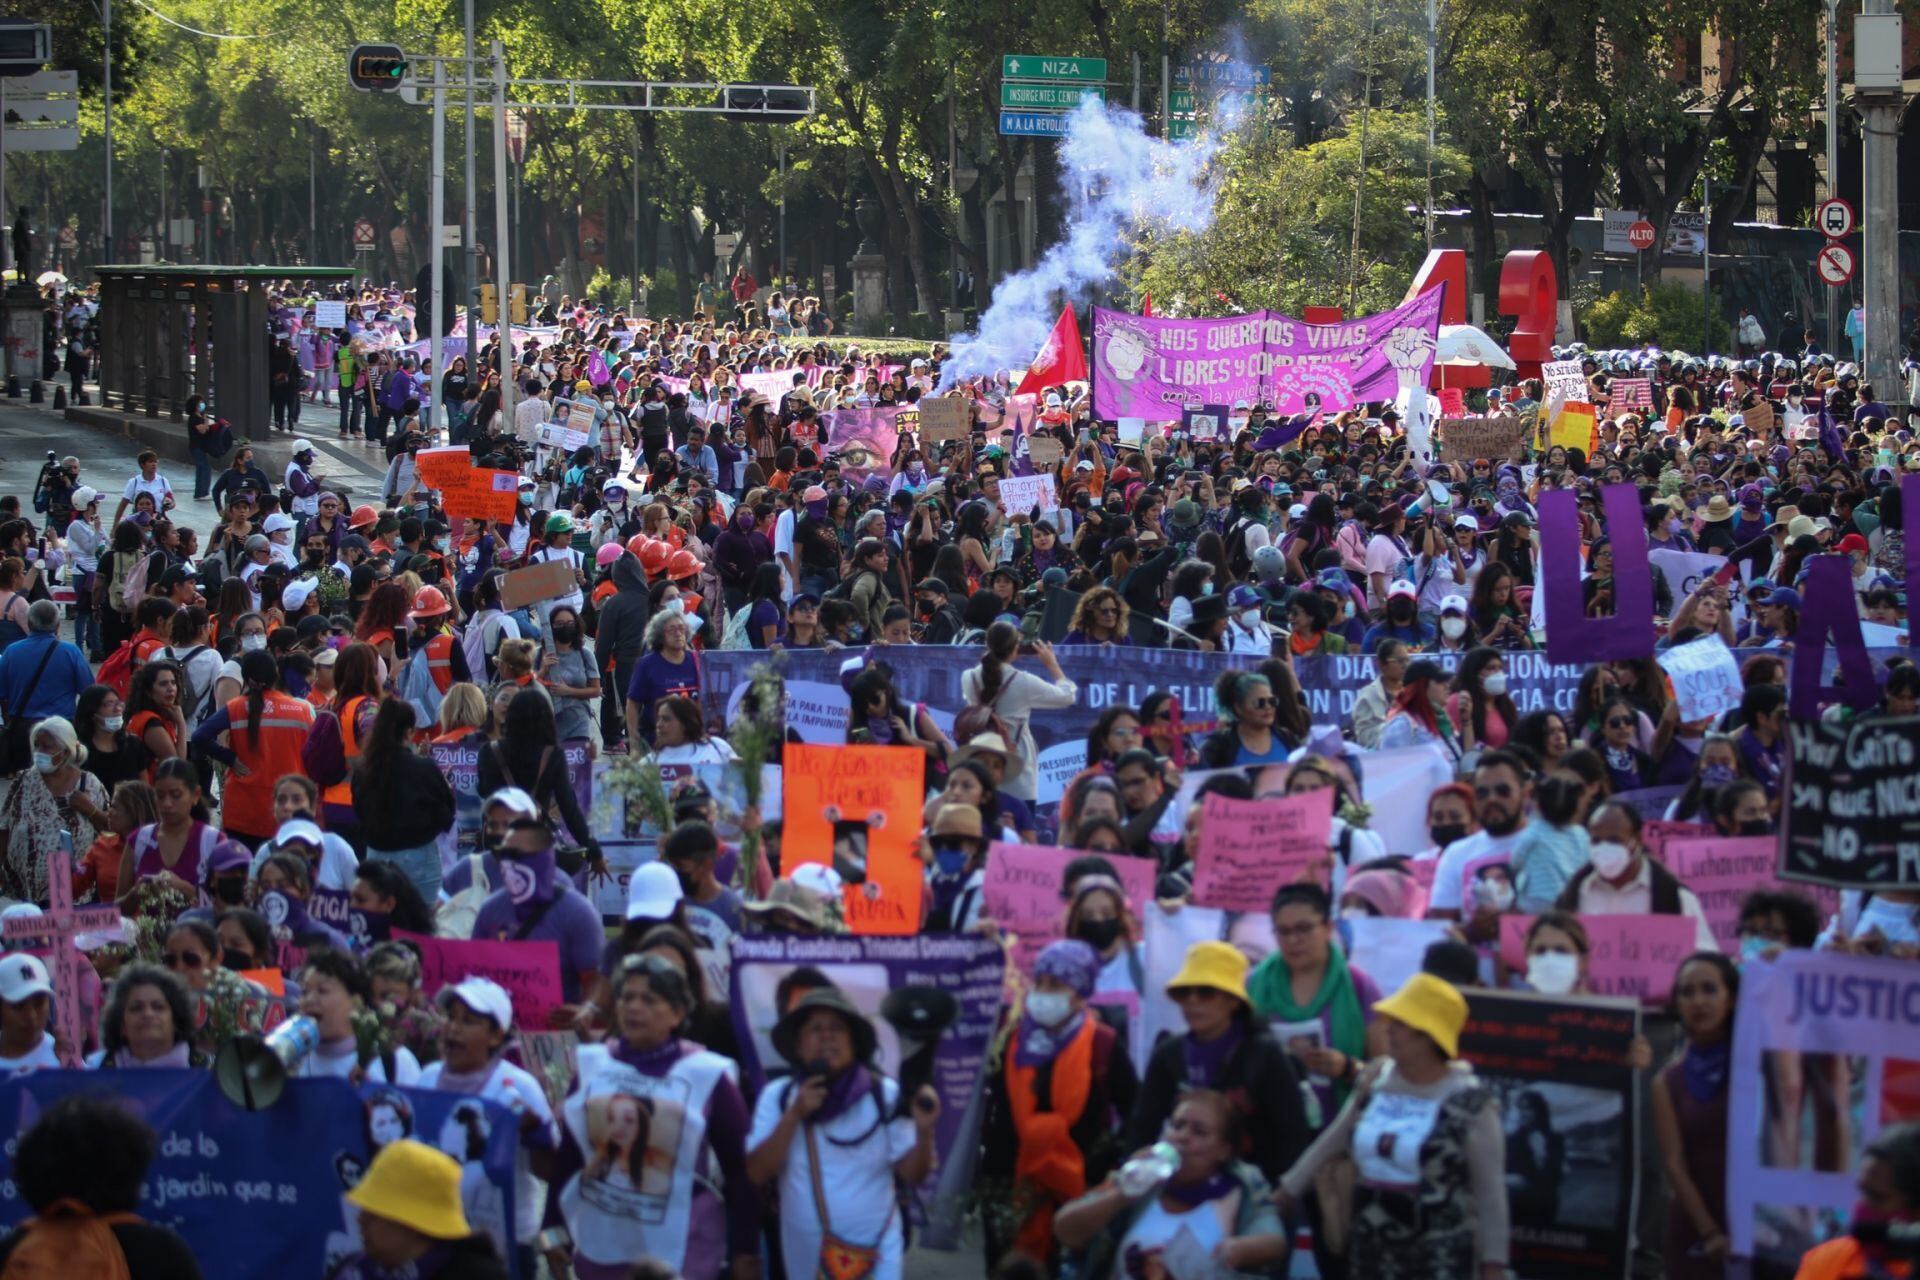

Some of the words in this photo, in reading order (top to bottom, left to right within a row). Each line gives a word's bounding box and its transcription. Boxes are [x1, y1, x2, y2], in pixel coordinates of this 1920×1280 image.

[1042, 61, 1080, 75] NIZA
[1009, 87, 1056, 103] INSURGENTES
[1058, 89, 1084, 104] CENTR
[1025, 118, 1035, 131] LA
[1036, 119, 1072, 132] REVOLUC
[1629, 230, 1653, 241] ALTO
[1160, 327, 1198, 351] NOS
[1206, 318, 1294, 351] QUEREMOS
[1306, 324, 1367, 349] VIVAS
[1160, 357, 1231, 387] LIBRES
[1209, 386, 1223, 404] la
[1226, 379, 1277, 402] violenci
[1336, 656, 1377, 680] DIA
[1089, 683, 1119, 708] DE
[786, 711, 799, 723] LA
[801, 715, 849, 730] IMPUNIDA
[799, 701, 825, 715] PARA
[827, 706, 849, 718] TODA
[432, 746, 478, 765] Zule
[1038, 753, 1088, 773] PRESUPUES
[1046, 773, 1052, 783] Y
[1828, 788, 1873, 818] QUE
[1822, 824, 1859, 862] NO
[733, 934, 784, 959] Brenda
[786, 935, 862, 962] Guadalupe
[161, 1131, 192, 1158] de
[197, 1131, 220, 1158] la
[234, 1178, 272, 1203] que
[277, 1181, 298, 1204] se
